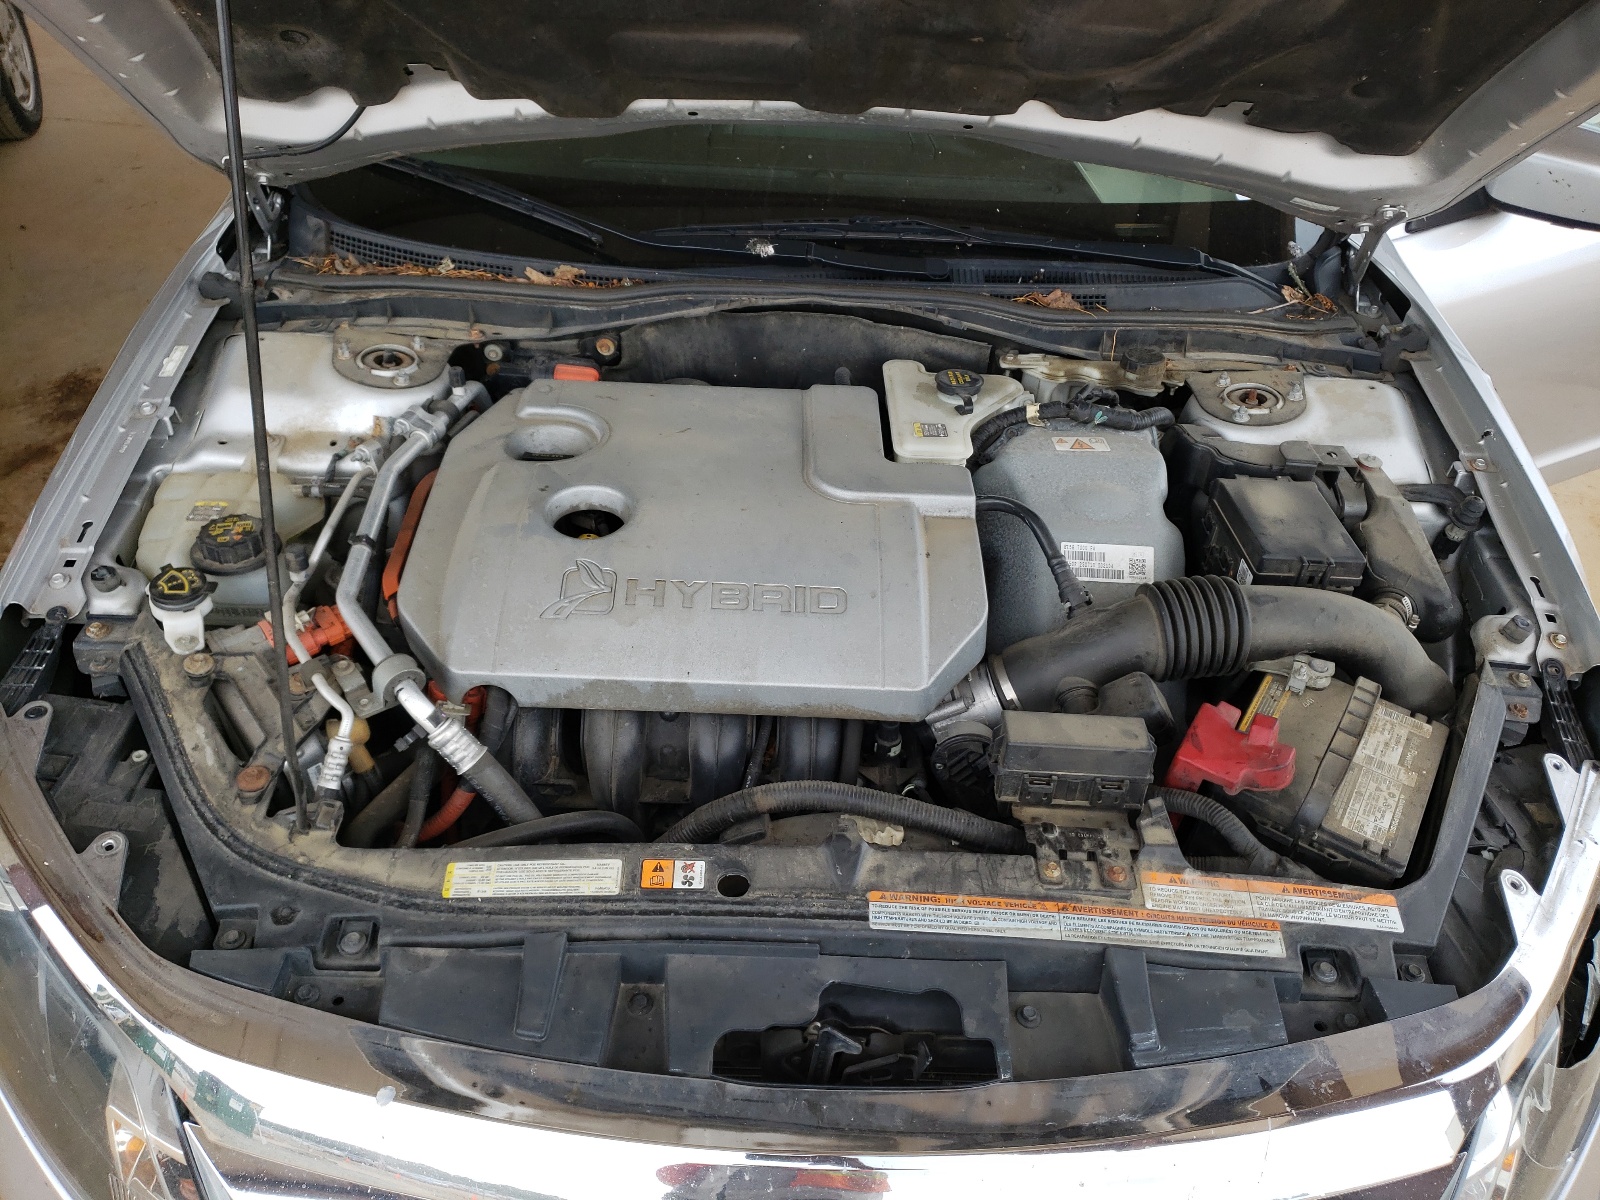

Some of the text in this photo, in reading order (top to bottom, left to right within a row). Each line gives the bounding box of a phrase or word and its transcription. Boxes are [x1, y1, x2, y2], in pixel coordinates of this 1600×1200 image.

[625, 578, 848, 614] HYBRID
[890, 893, 941, 905] WARNING:
[968, 898, 1002, 908] VOLTAGE
[1004, 900, 1037, 910] VEHICLE
[1072, 906, 1139, 919] AVERTISSEMENT
